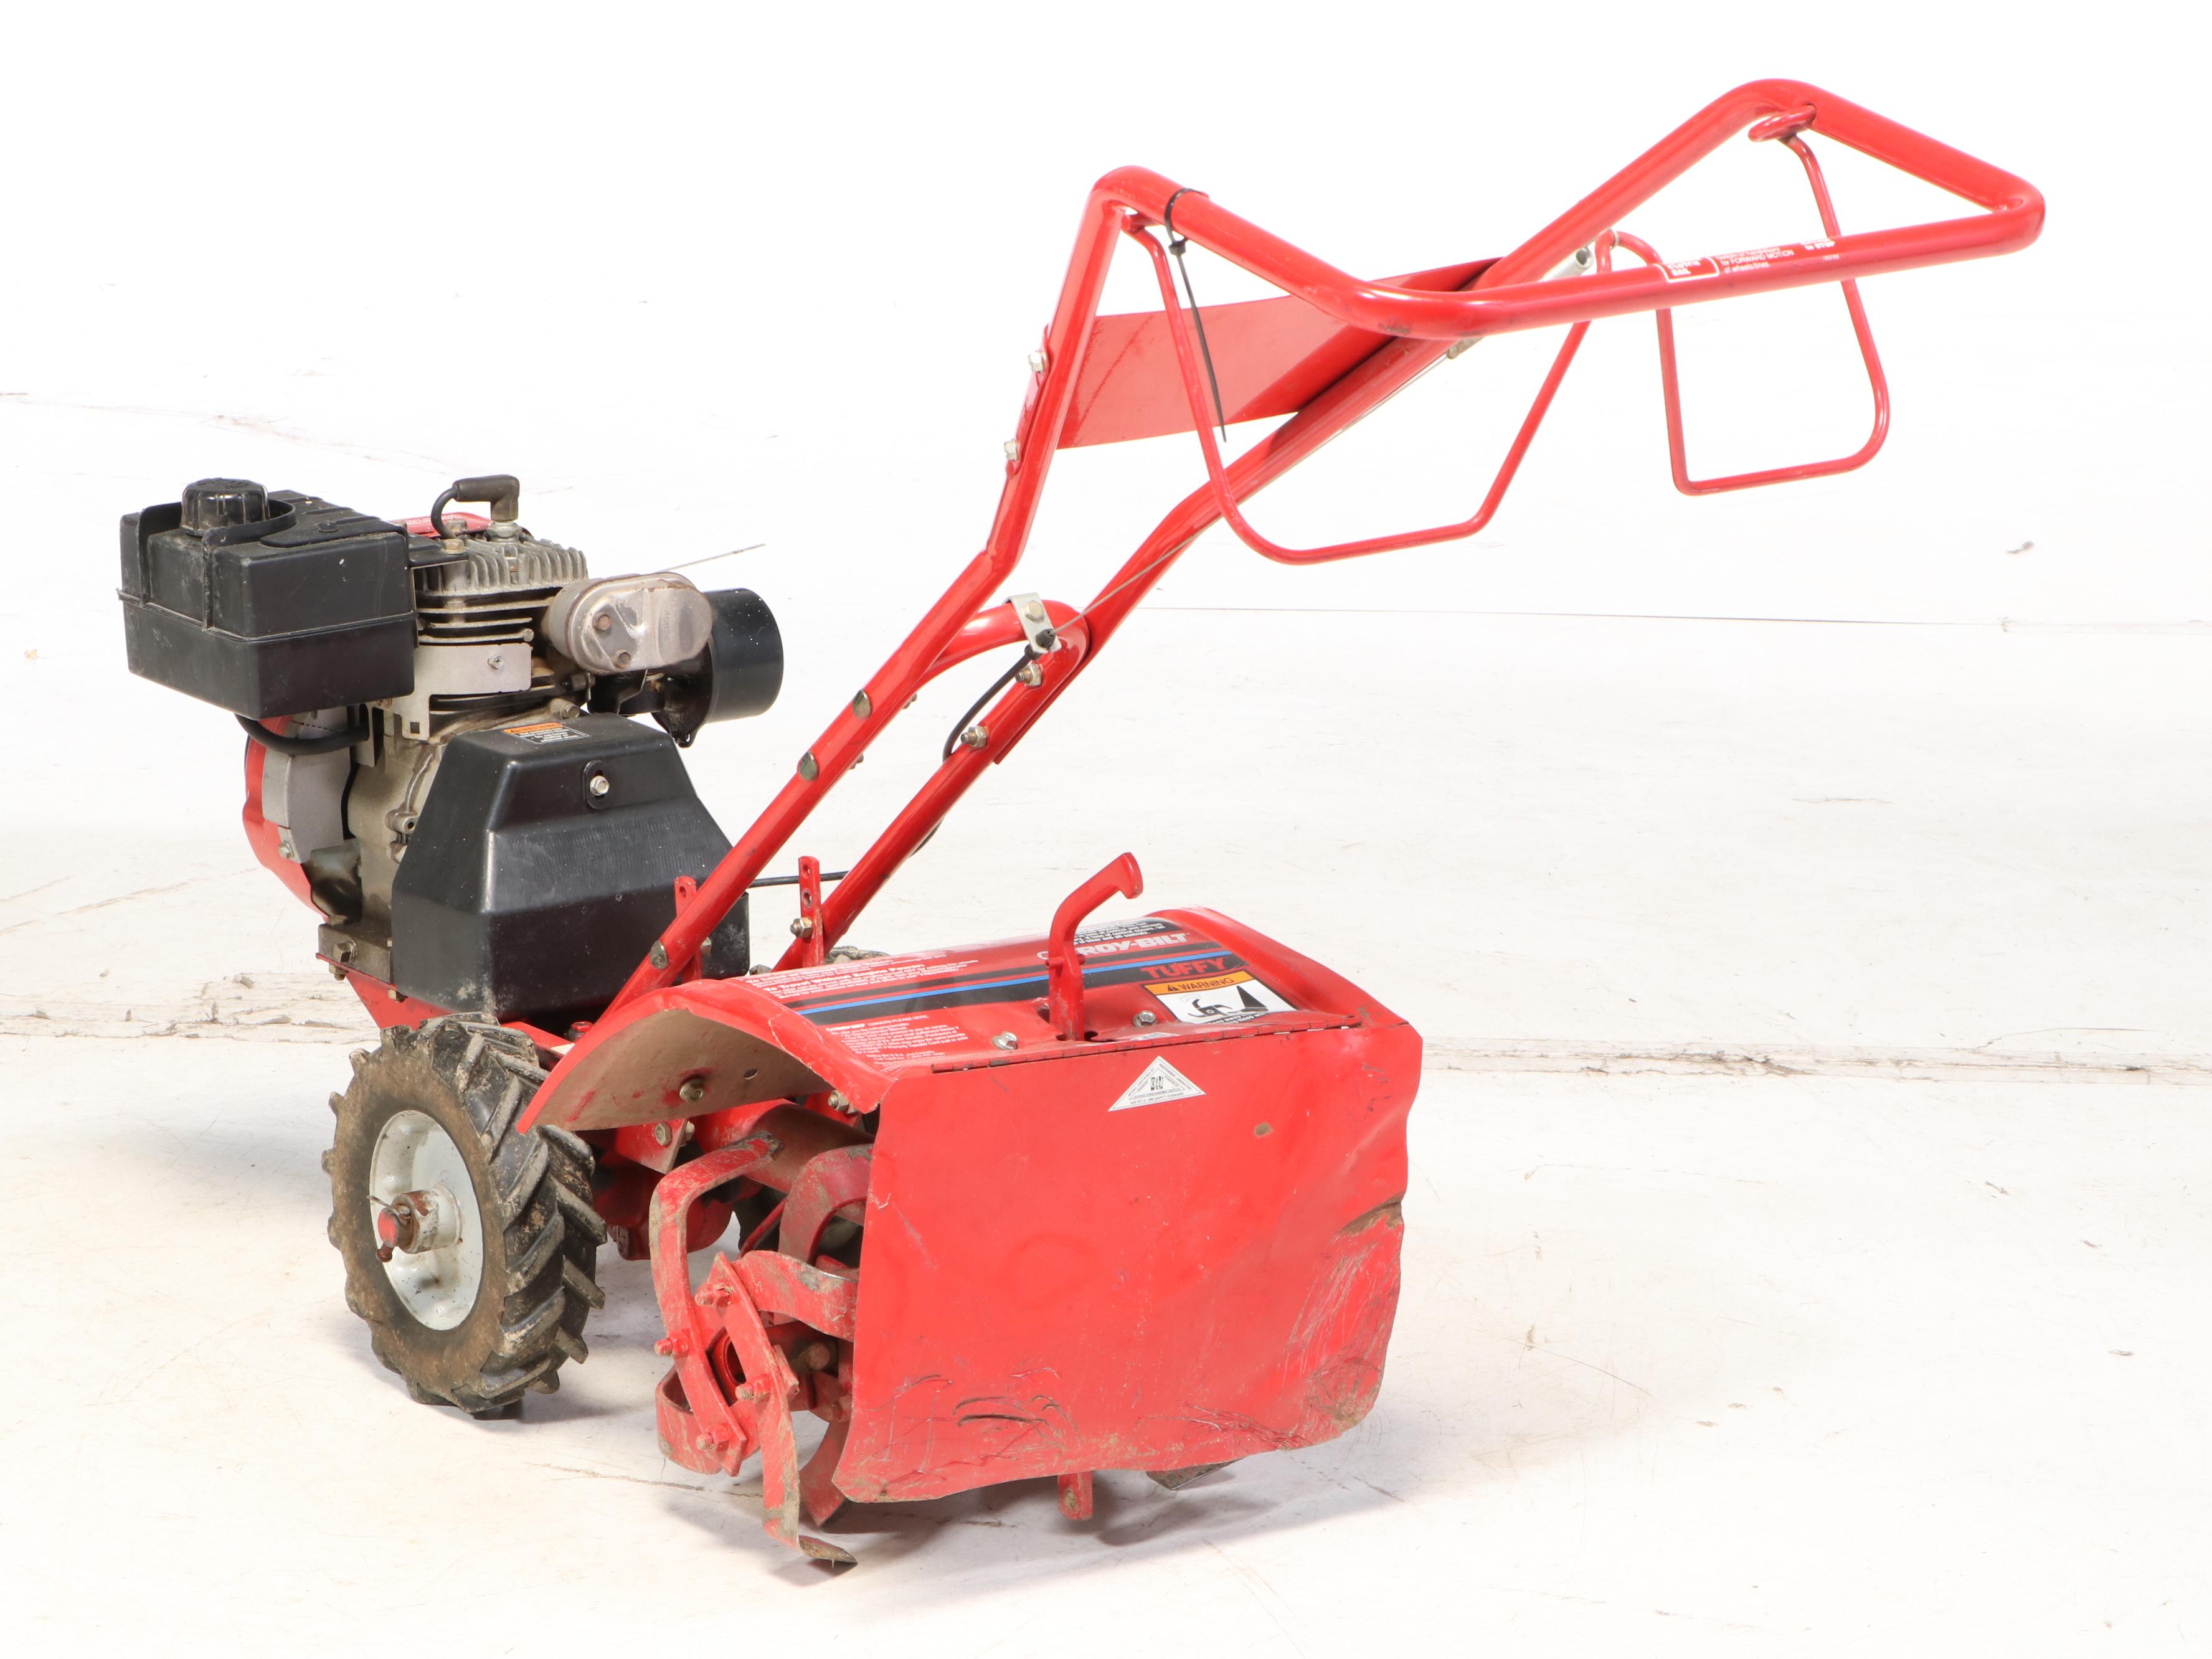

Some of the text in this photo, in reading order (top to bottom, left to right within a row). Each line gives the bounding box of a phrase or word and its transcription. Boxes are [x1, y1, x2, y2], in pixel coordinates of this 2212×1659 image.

[1815, 240, 1835, 249] STOP
[1731, 253, 1766, 264] FORWARD
[1766, 249, 1795, 260] MOTION
[1671, 268, 1692, 277] BAIL
[1075, 933, 1188, 956] ROY-BILT
[1140, 957, 1227, 978] TUFFY
[1178, 976, 1235, 991] WARNING
